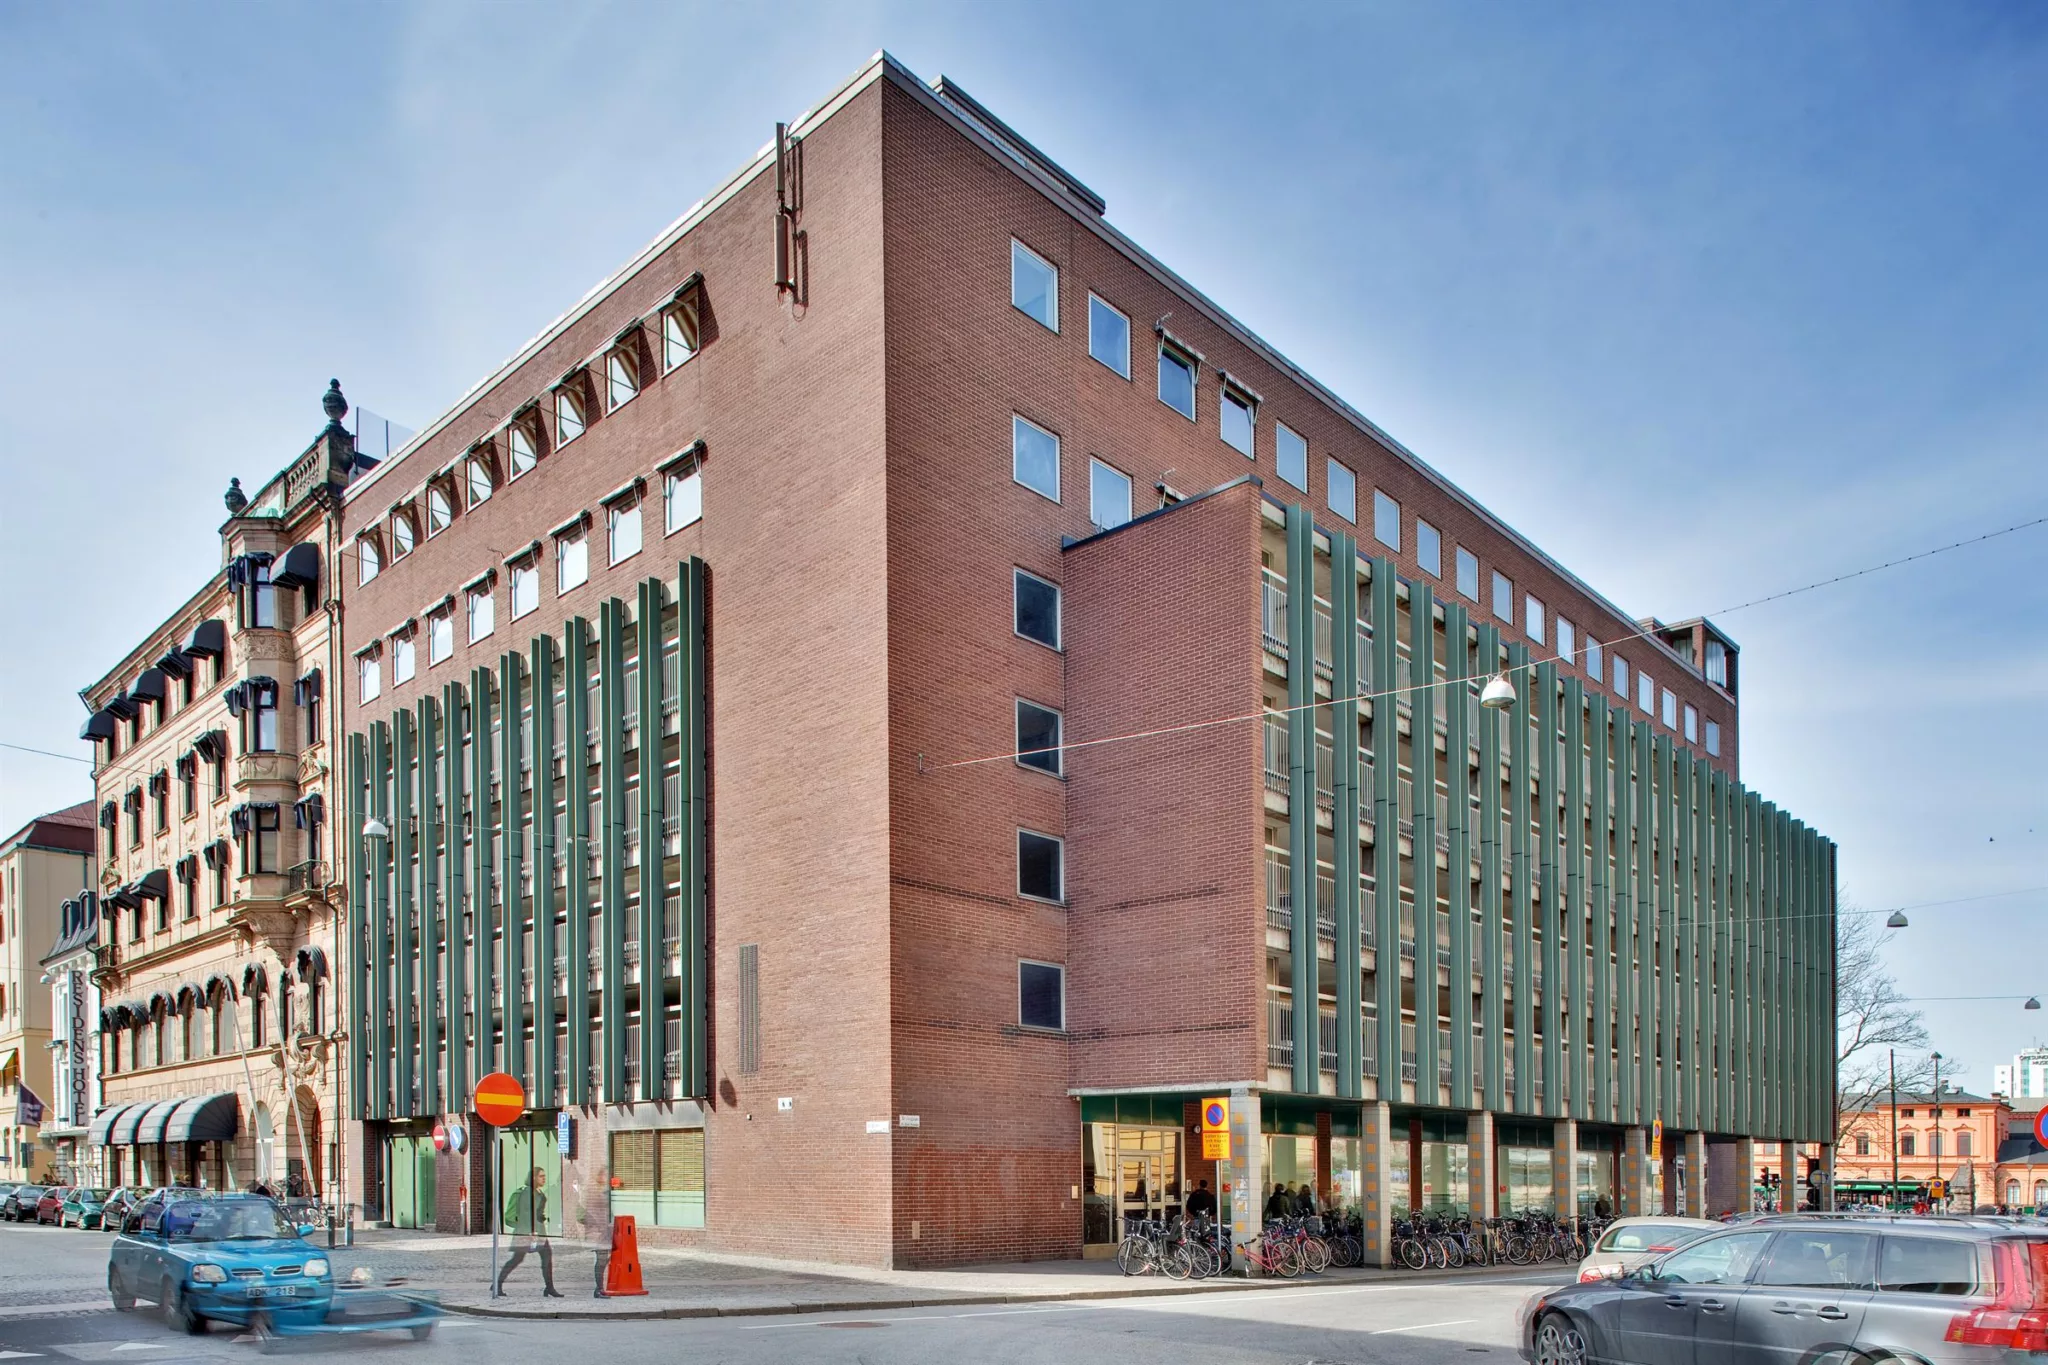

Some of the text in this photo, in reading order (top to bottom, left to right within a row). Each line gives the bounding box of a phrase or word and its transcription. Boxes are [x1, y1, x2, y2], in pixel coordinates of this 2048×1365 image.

[72, 970, 86, 1127] RESIDENS HOTEL
[560, 1114, 566, 1128] P
[275, 1287, 294, 1296] 218
